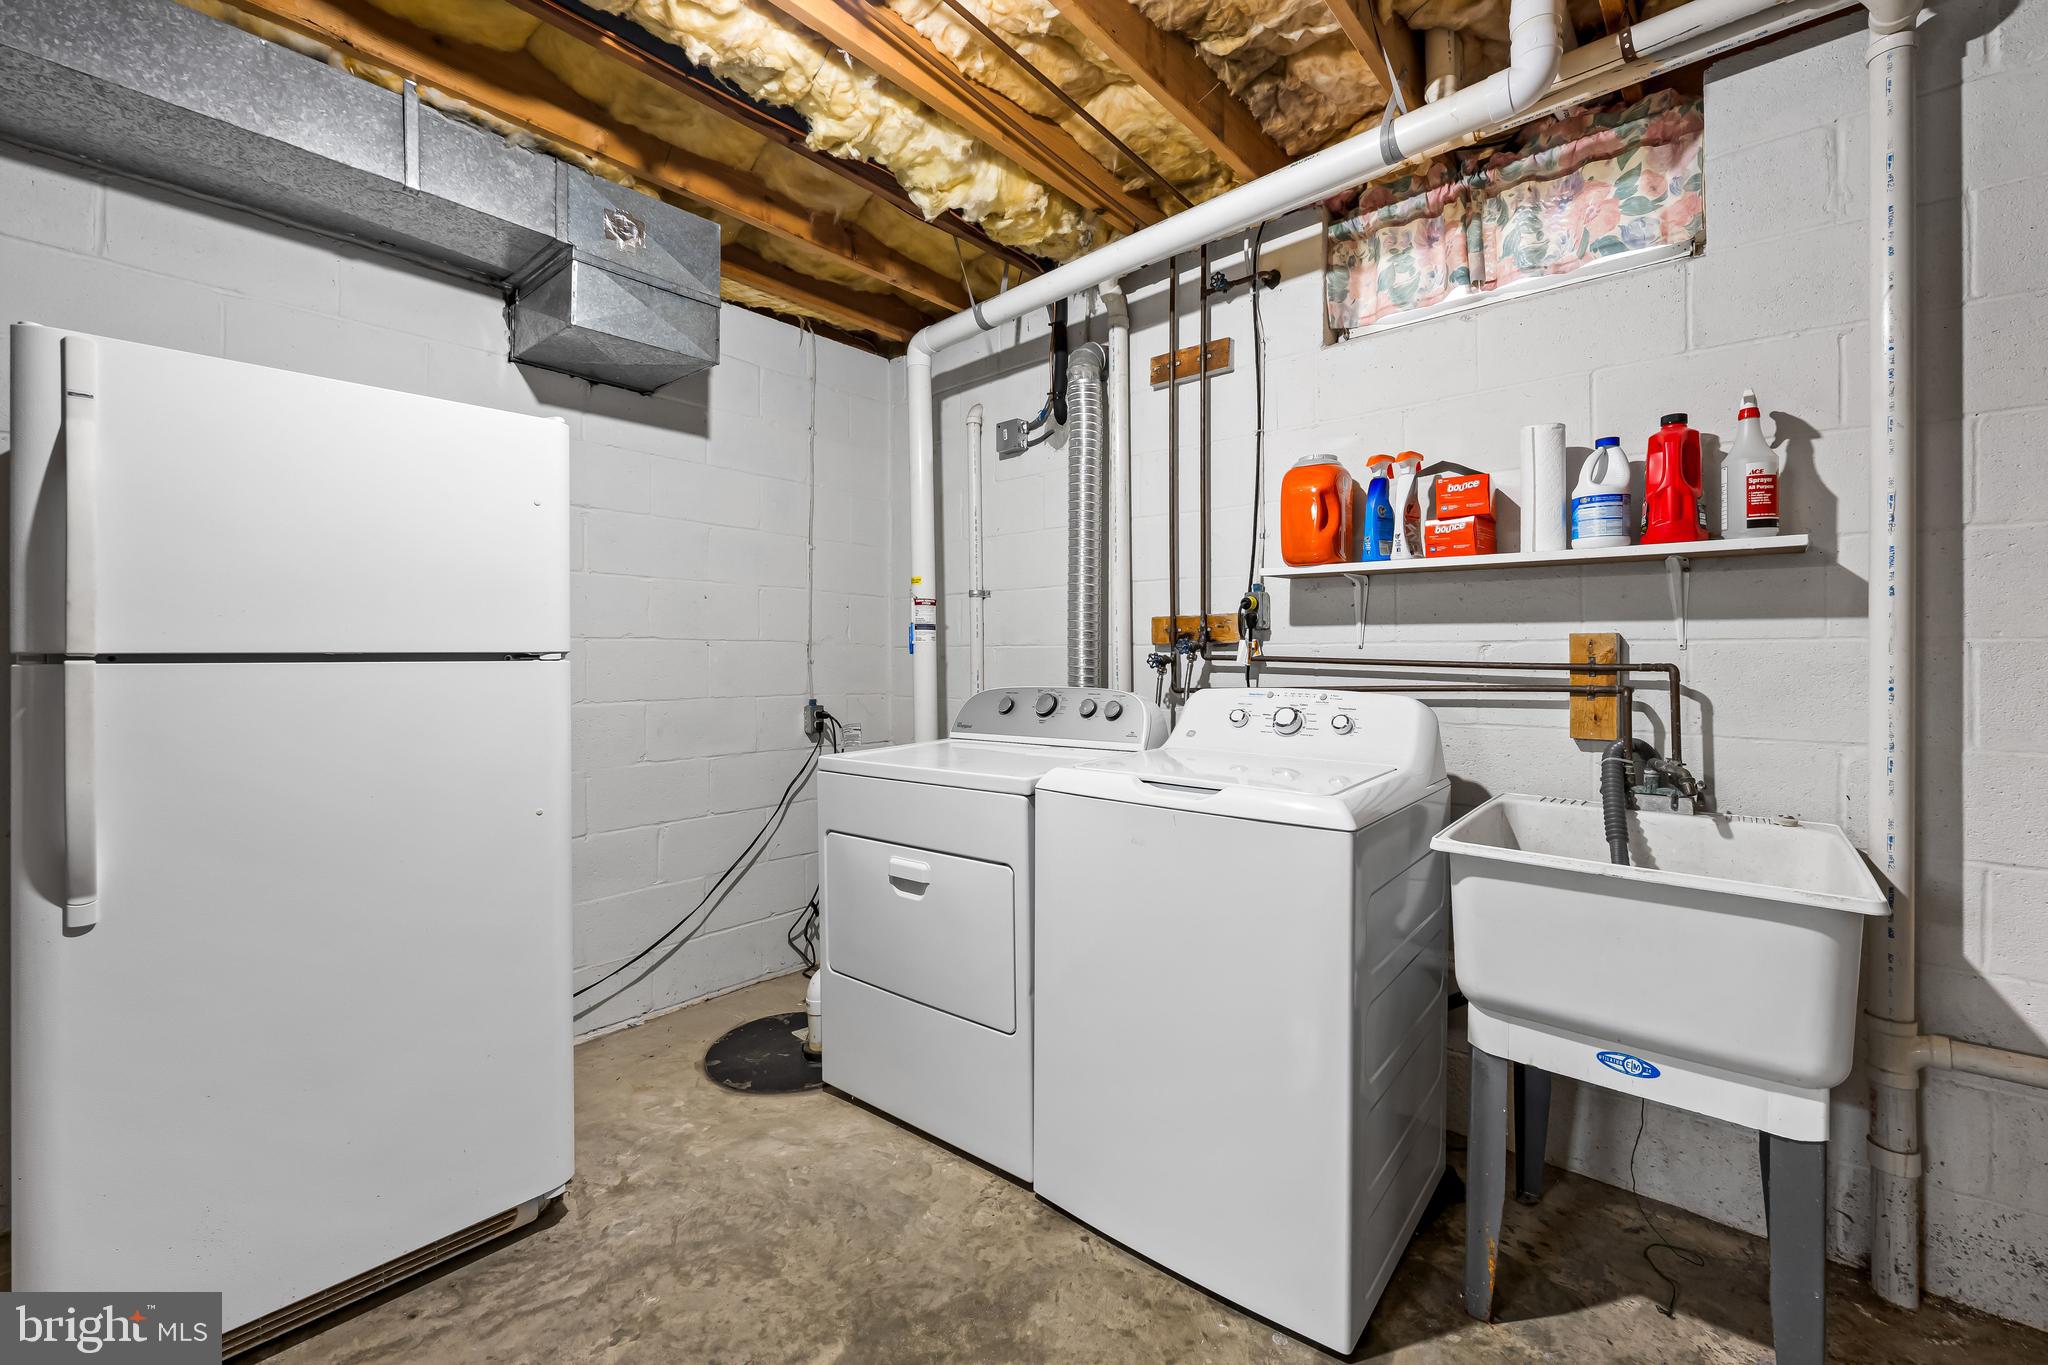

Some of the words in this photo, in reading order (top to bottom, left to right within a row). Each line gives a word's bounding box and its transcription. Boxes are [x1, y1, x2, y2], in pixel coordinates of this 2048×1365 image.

[1447, 480, 1480, 492] bounce
[1748, 477, 1773, 485] Sprayer
[1434, 522, 1466, 534] bounce
